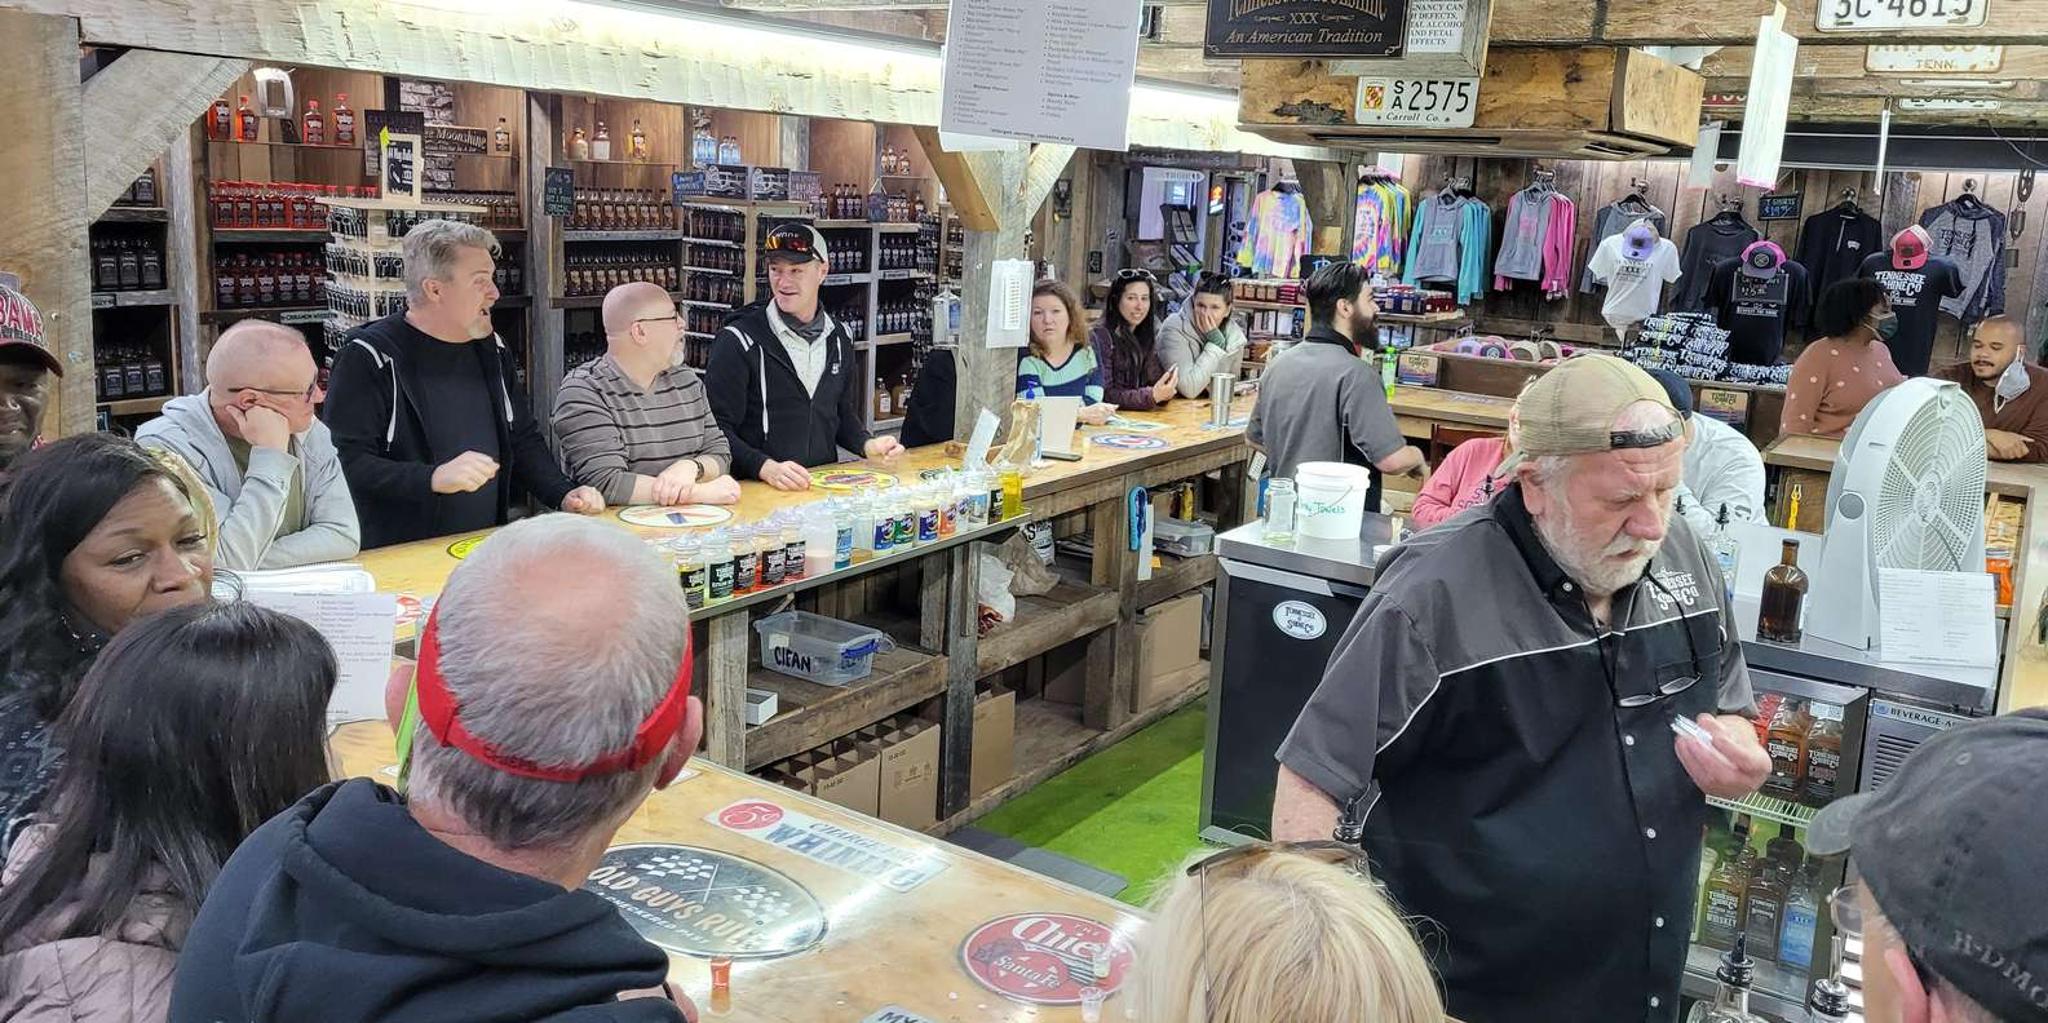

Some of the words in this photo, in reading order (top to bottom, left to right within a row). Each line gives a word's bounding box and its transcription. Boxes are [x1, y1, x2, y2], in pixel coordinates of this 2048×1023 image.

[1289, 12, 1319, 25] XXX
[1445, 3, 1464, 11] CAN
[1225, 29, 1245, 44] An
[1246, 29, 1313, 44] American
[1318, 27, 1383, 44] Tradition
[1408, 80, 1471, 113] 2575
[1386, 112, 1421, 122] Carroll
[1875, 271, 1927, 285] TENNESSEE
[774, 646, 811, 673] CLEAN
[808, 822, 880, 849] CHARGE
[587, 865, 641, 892] OLD
[630, 885, 705, 920] GUYS
[604, 895, 678, 931] CHECKERED
[993, 954, 1042, 986] Santa
